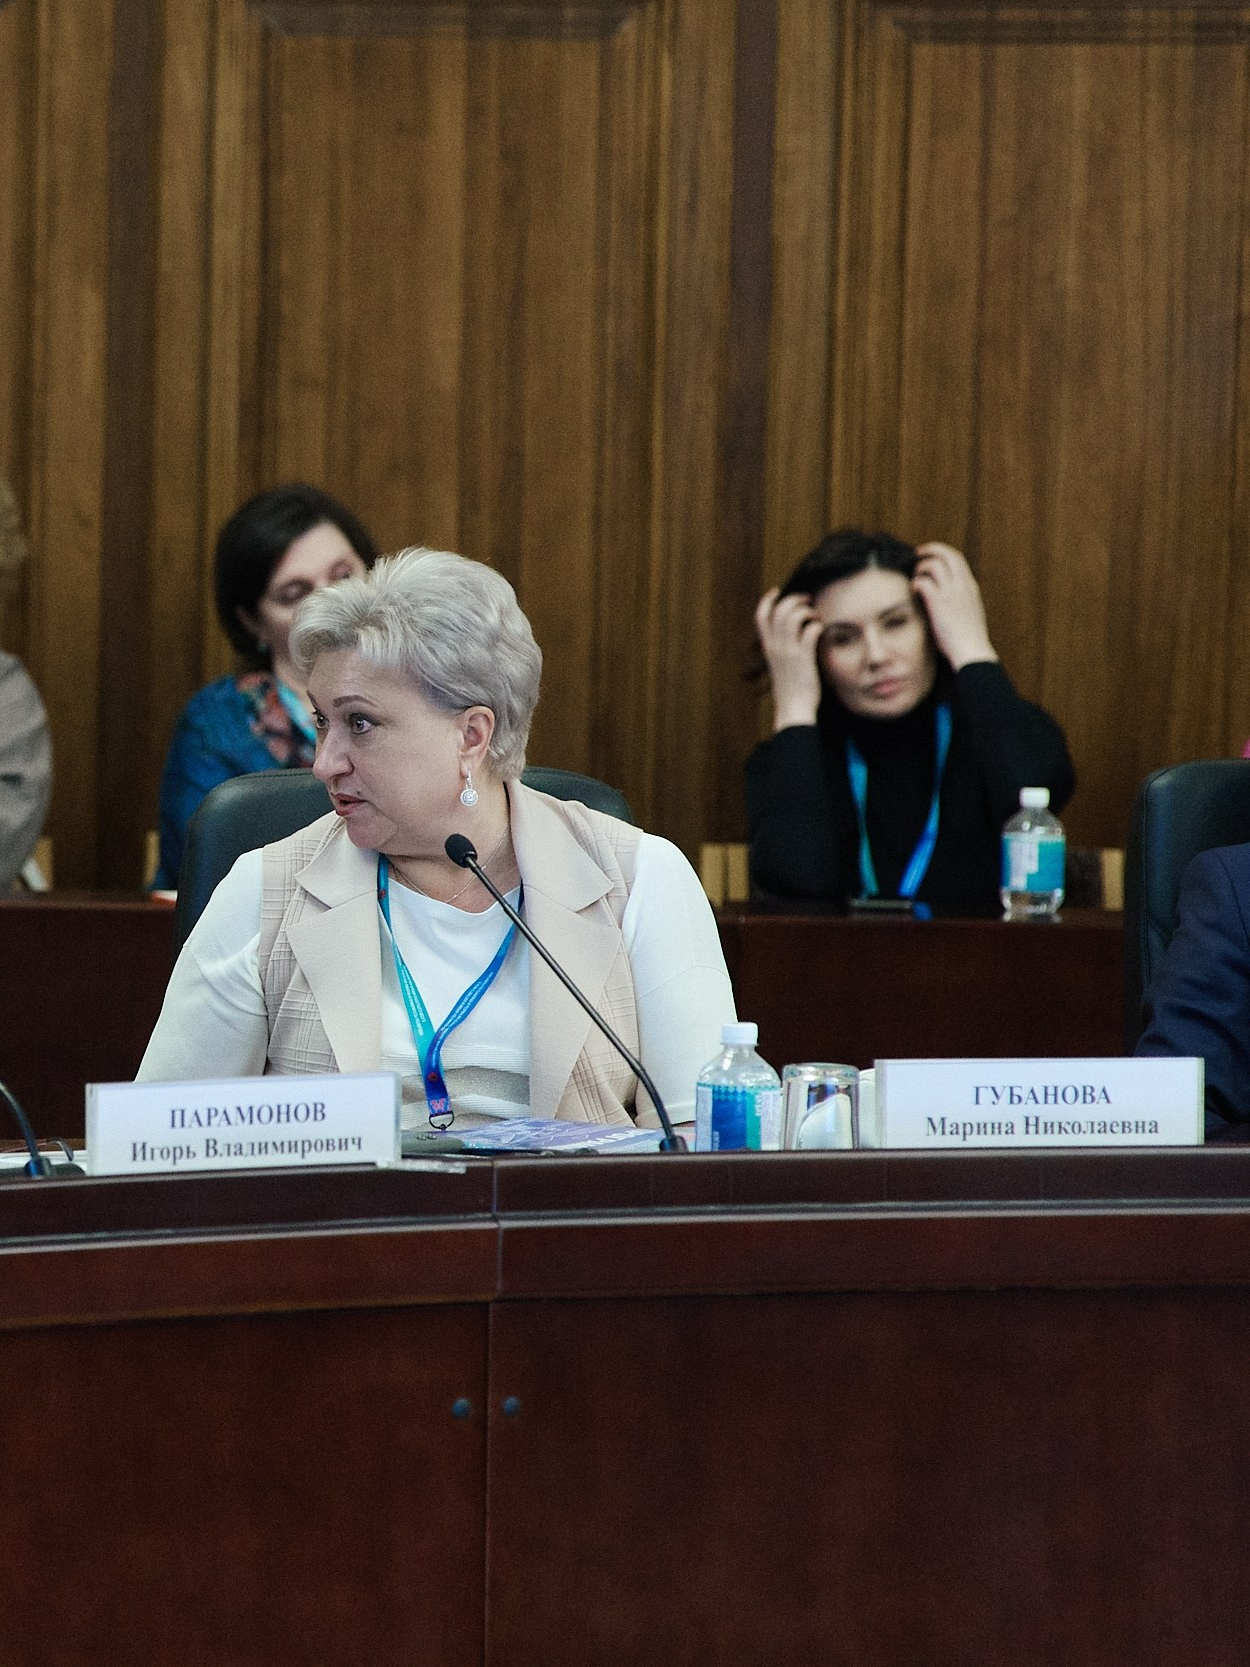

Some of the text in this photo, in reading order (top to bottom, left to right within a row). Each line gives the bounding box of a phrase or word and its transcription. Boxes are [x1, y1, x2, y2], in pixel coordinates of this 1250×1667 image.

[973, 1085, 1112, 1106] ГУБАНОВА
[169, 1102, 327, 1129] ПАРАМОНОВ
[925, 1115, 1160, 1141] Марина Николаевна
[131, 1136, 363, 1165] Игорь Владимирович
